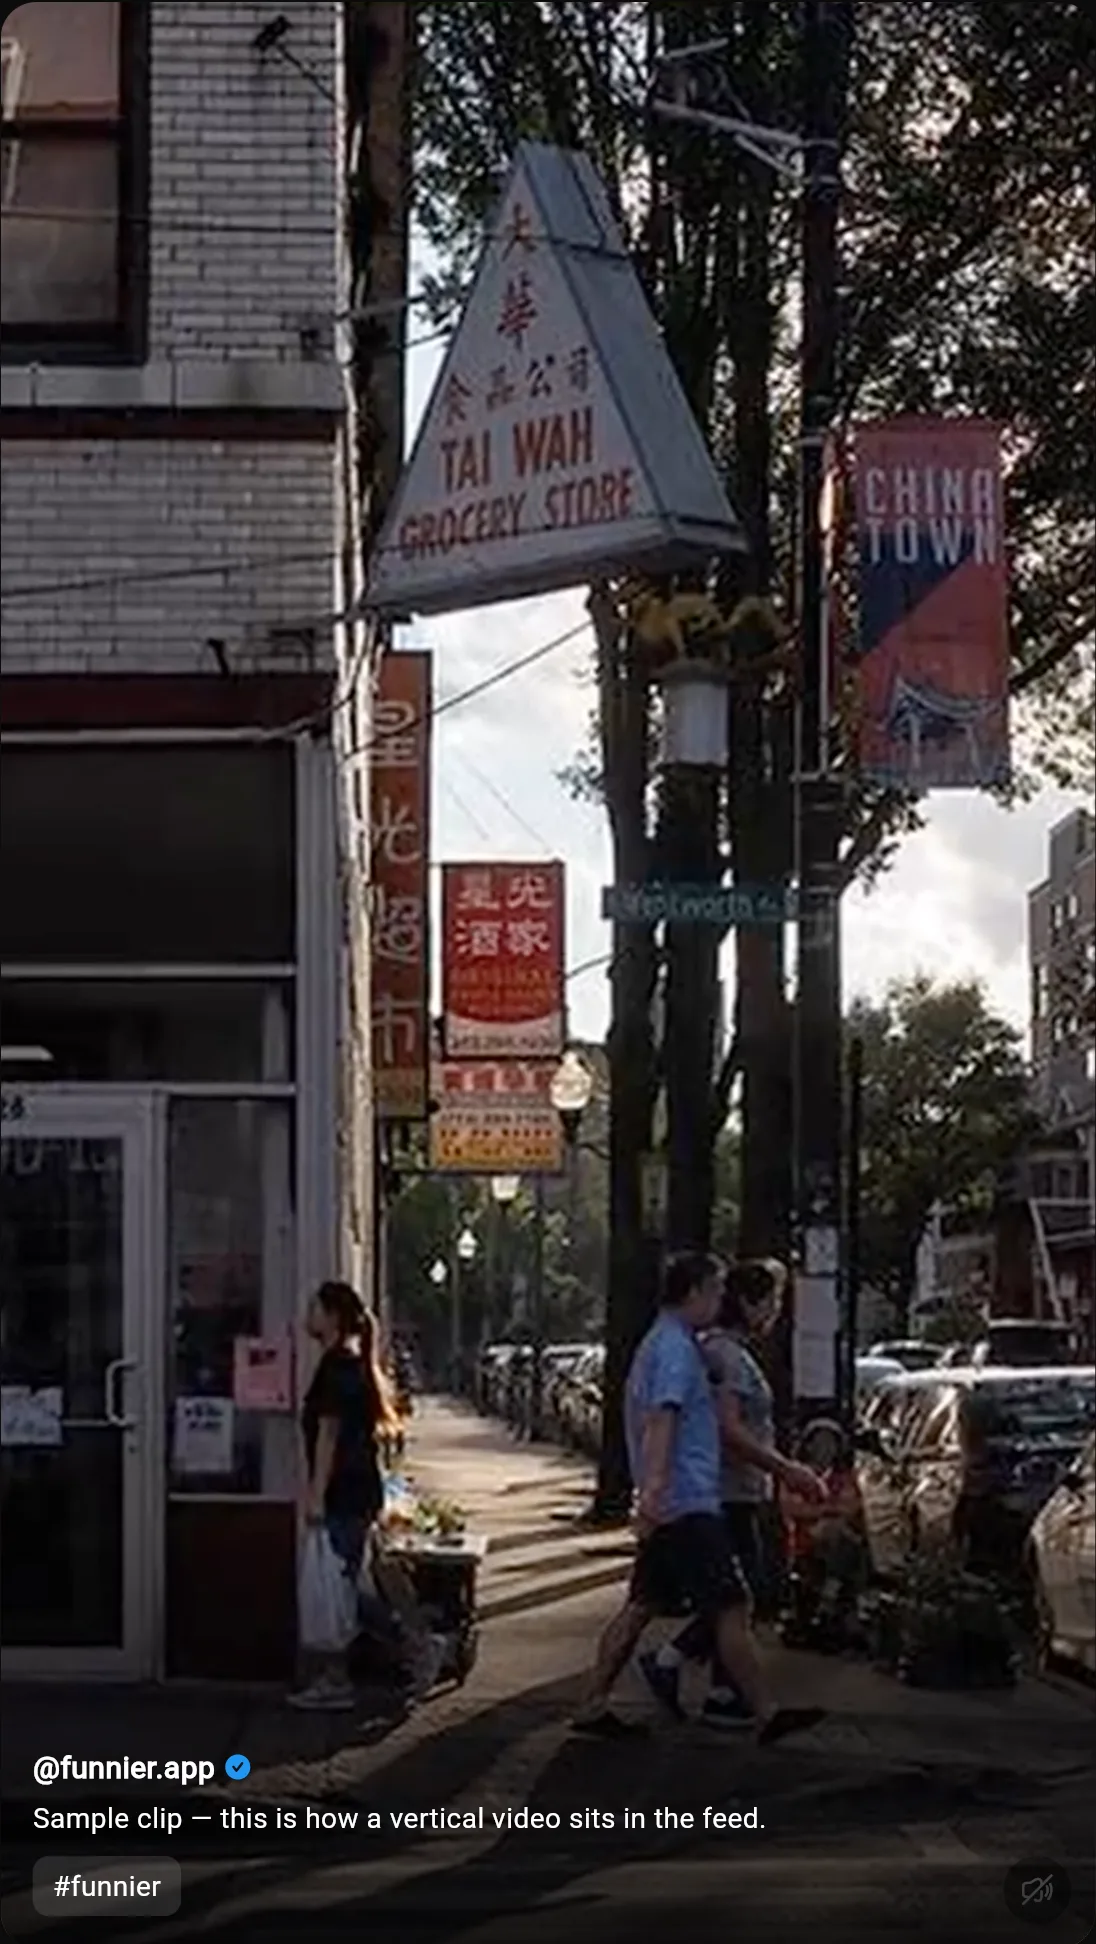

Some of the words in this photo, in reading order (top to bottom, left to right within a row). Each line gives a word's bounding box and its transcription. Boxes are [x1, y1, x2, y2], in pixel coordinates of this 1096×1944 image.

[440, 431, 491, 493] TAI
[513, 407, 593, 478] WAH
[399, 493, 527, 561] GROCERY
[545, 468, 634, 529] STORE
[864, 467, 996, 516] CHINA
[865, 519, 996, 567] TOWN
[453, 919, 552, 957] 酒家
